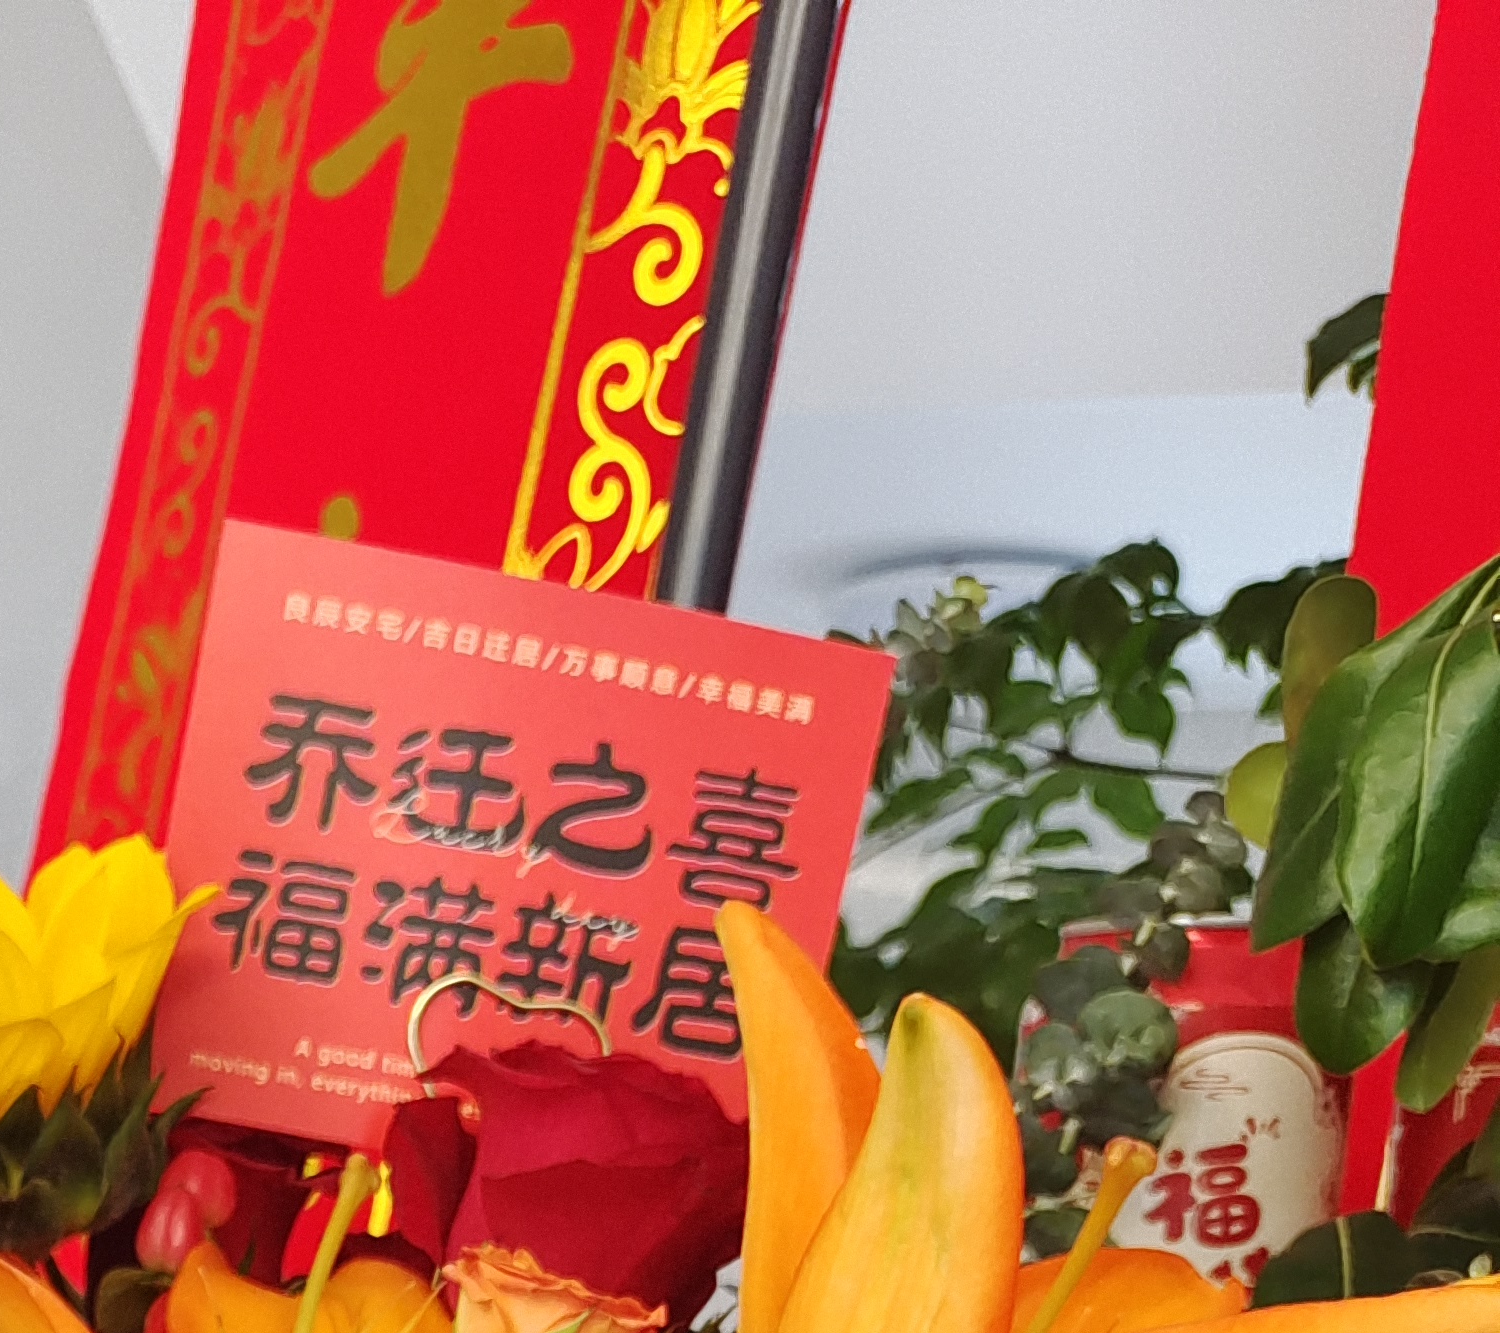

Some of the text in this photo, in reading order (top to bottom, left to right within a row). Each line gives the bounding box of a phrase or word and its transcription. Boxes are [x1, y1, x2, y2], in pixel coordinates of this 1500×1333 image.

[244, 693, 800, 908] 乔迁之喜
[212, 849, 743, 1061] 福满新居
[189, 1053, 271, 1086] moving
[310, 1072, 414, 1104] everythin
[317, 1048, 377, 1072] good
[1145, 1142, 1261, 1247] 福
